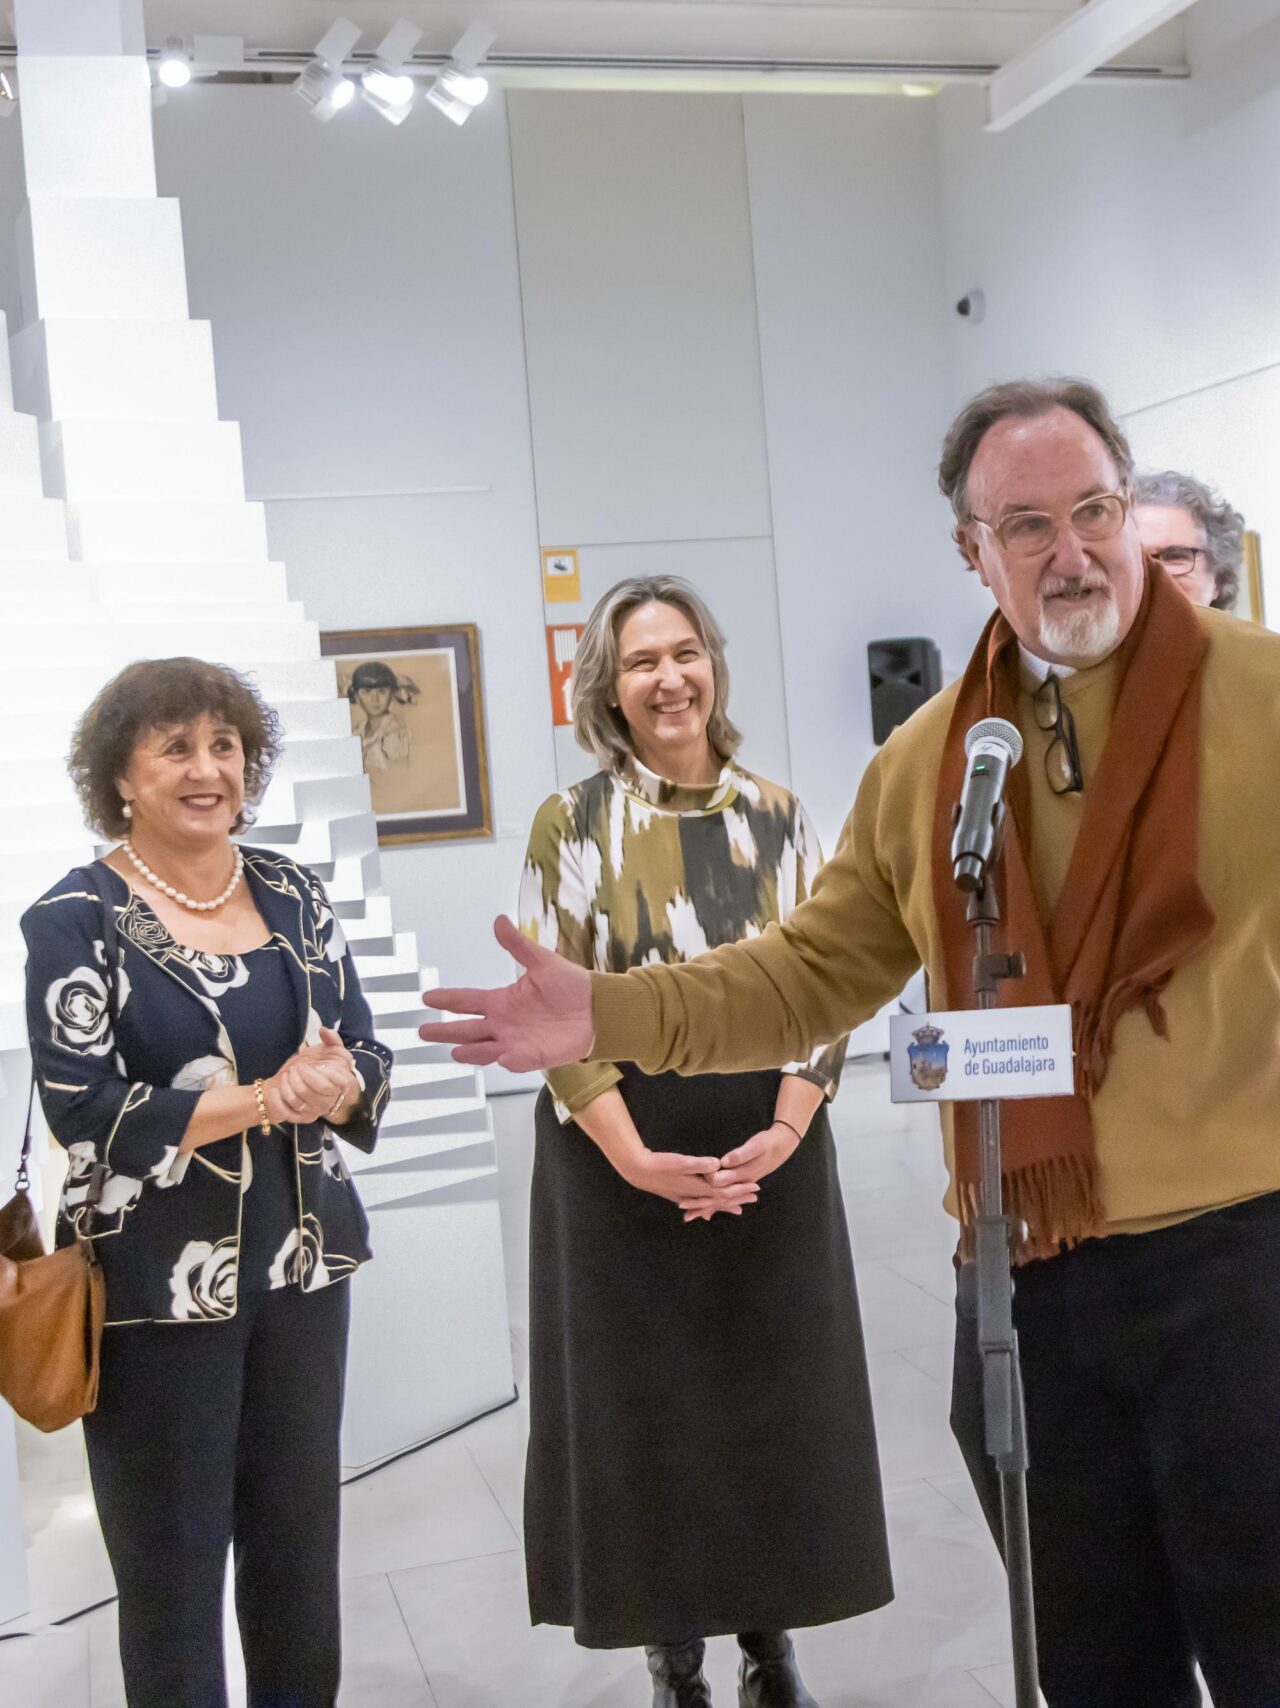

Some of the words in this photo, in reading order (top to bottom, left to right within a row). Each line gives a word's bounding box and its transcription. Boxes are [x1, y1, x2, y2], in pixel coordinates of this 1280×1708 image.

[964, 1034, 1049, 1057] Ayuntamiento
[964, 1059, 979, 1076] de
[982, 1056, 1055, 1076] Guadalajara
